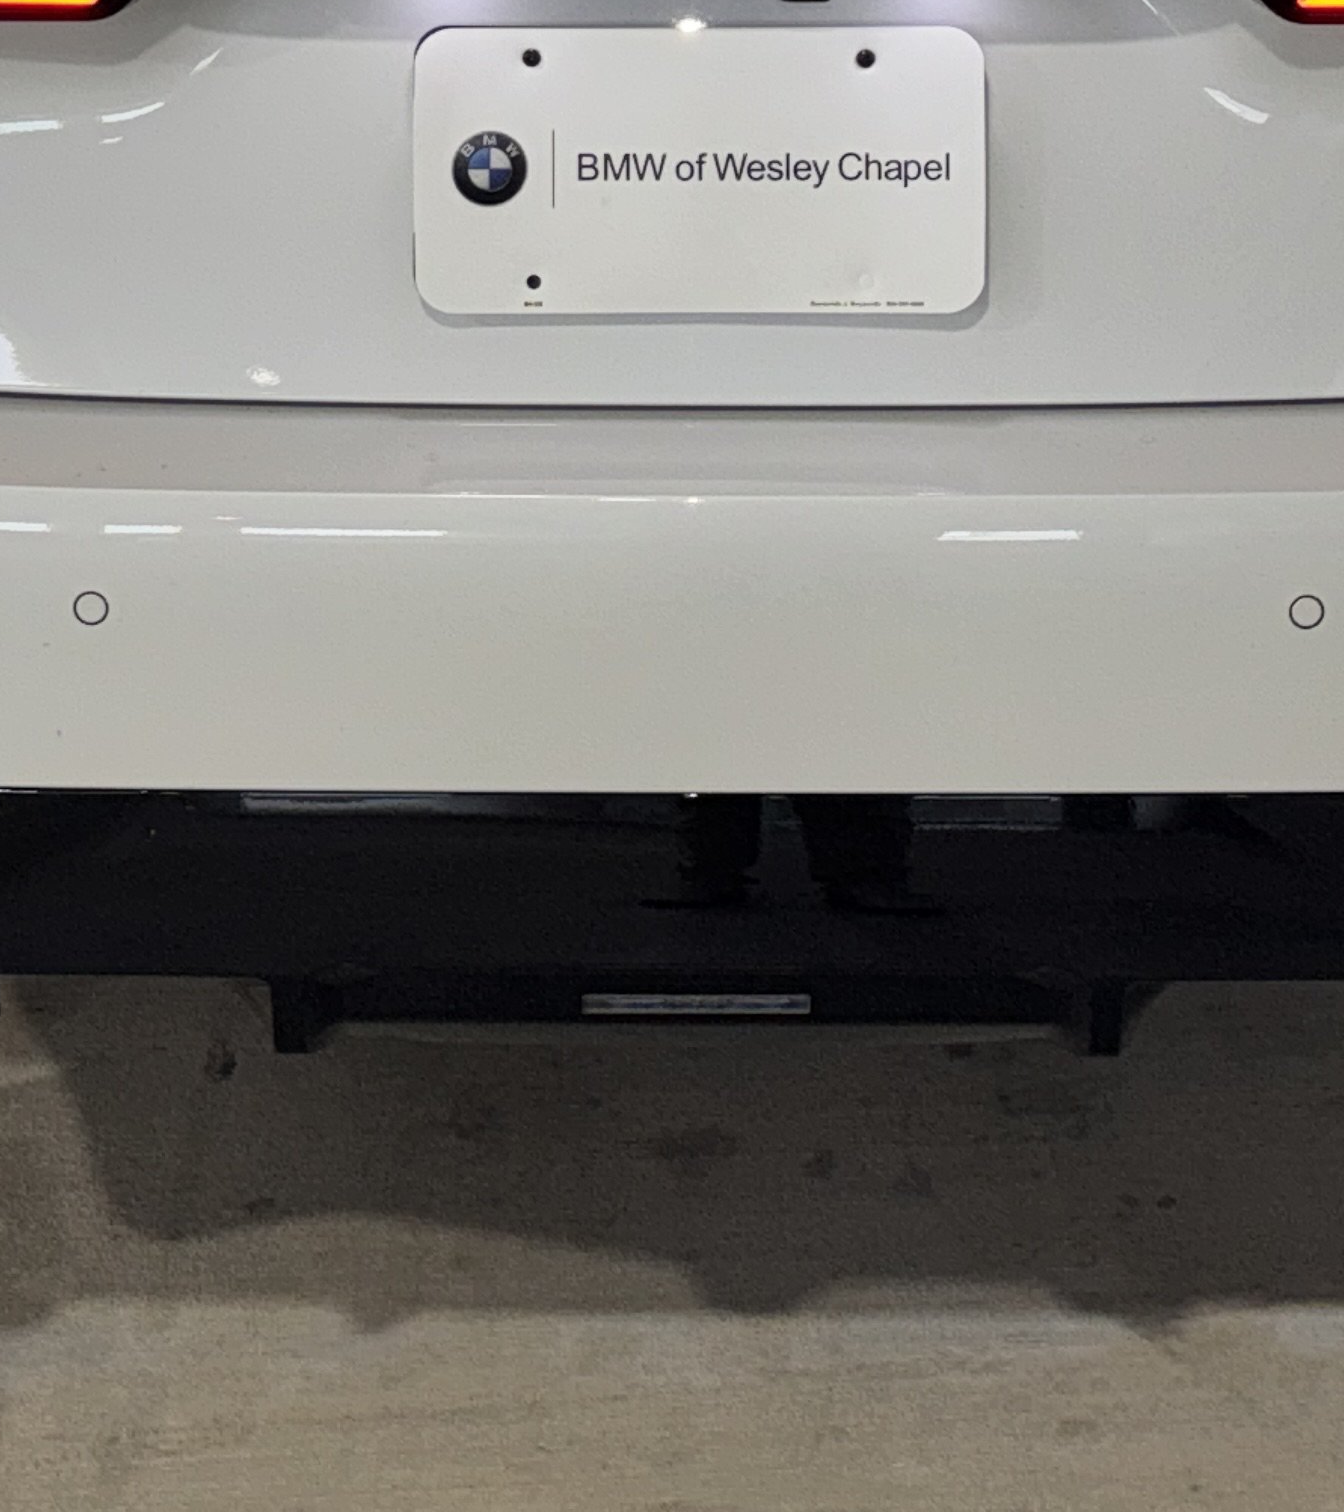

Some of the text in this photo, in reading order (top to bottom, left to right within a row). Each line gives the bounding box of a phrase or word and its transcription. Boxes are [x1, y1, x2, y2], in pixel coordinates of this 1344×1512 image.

[459, 134, 521, 158] BMW
[577, 151, 951, 189] BMW of Wesley Chapel
